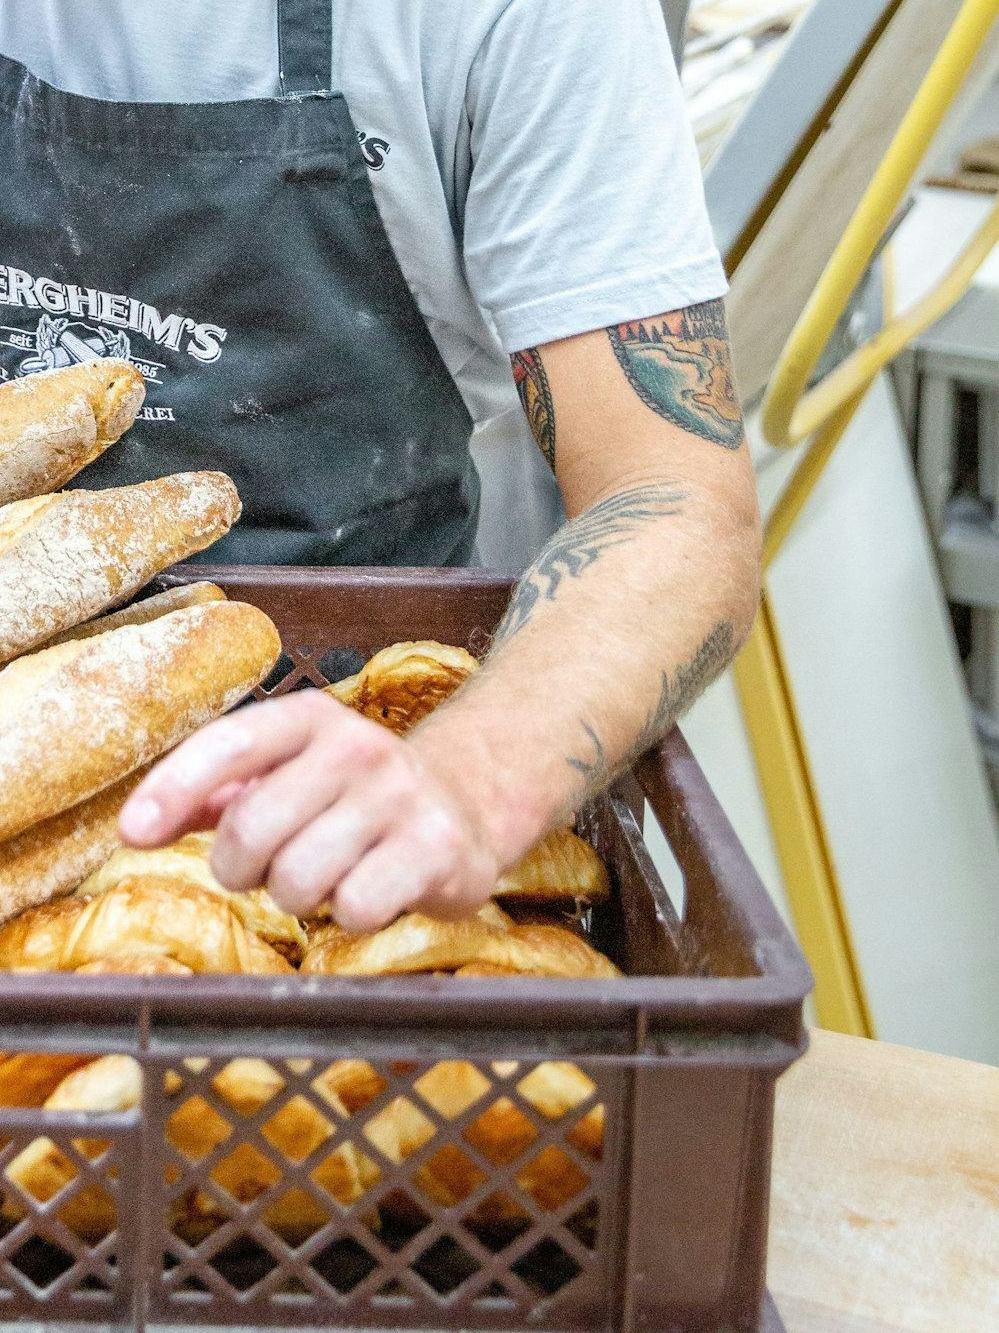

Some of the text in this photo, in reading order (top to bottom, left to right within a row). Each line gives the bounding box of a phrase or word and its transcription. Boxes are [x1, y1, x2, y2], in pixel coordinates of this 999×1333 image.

[9, 333, 159, 378] seit 985
[135, 407, 176, 421] REI
